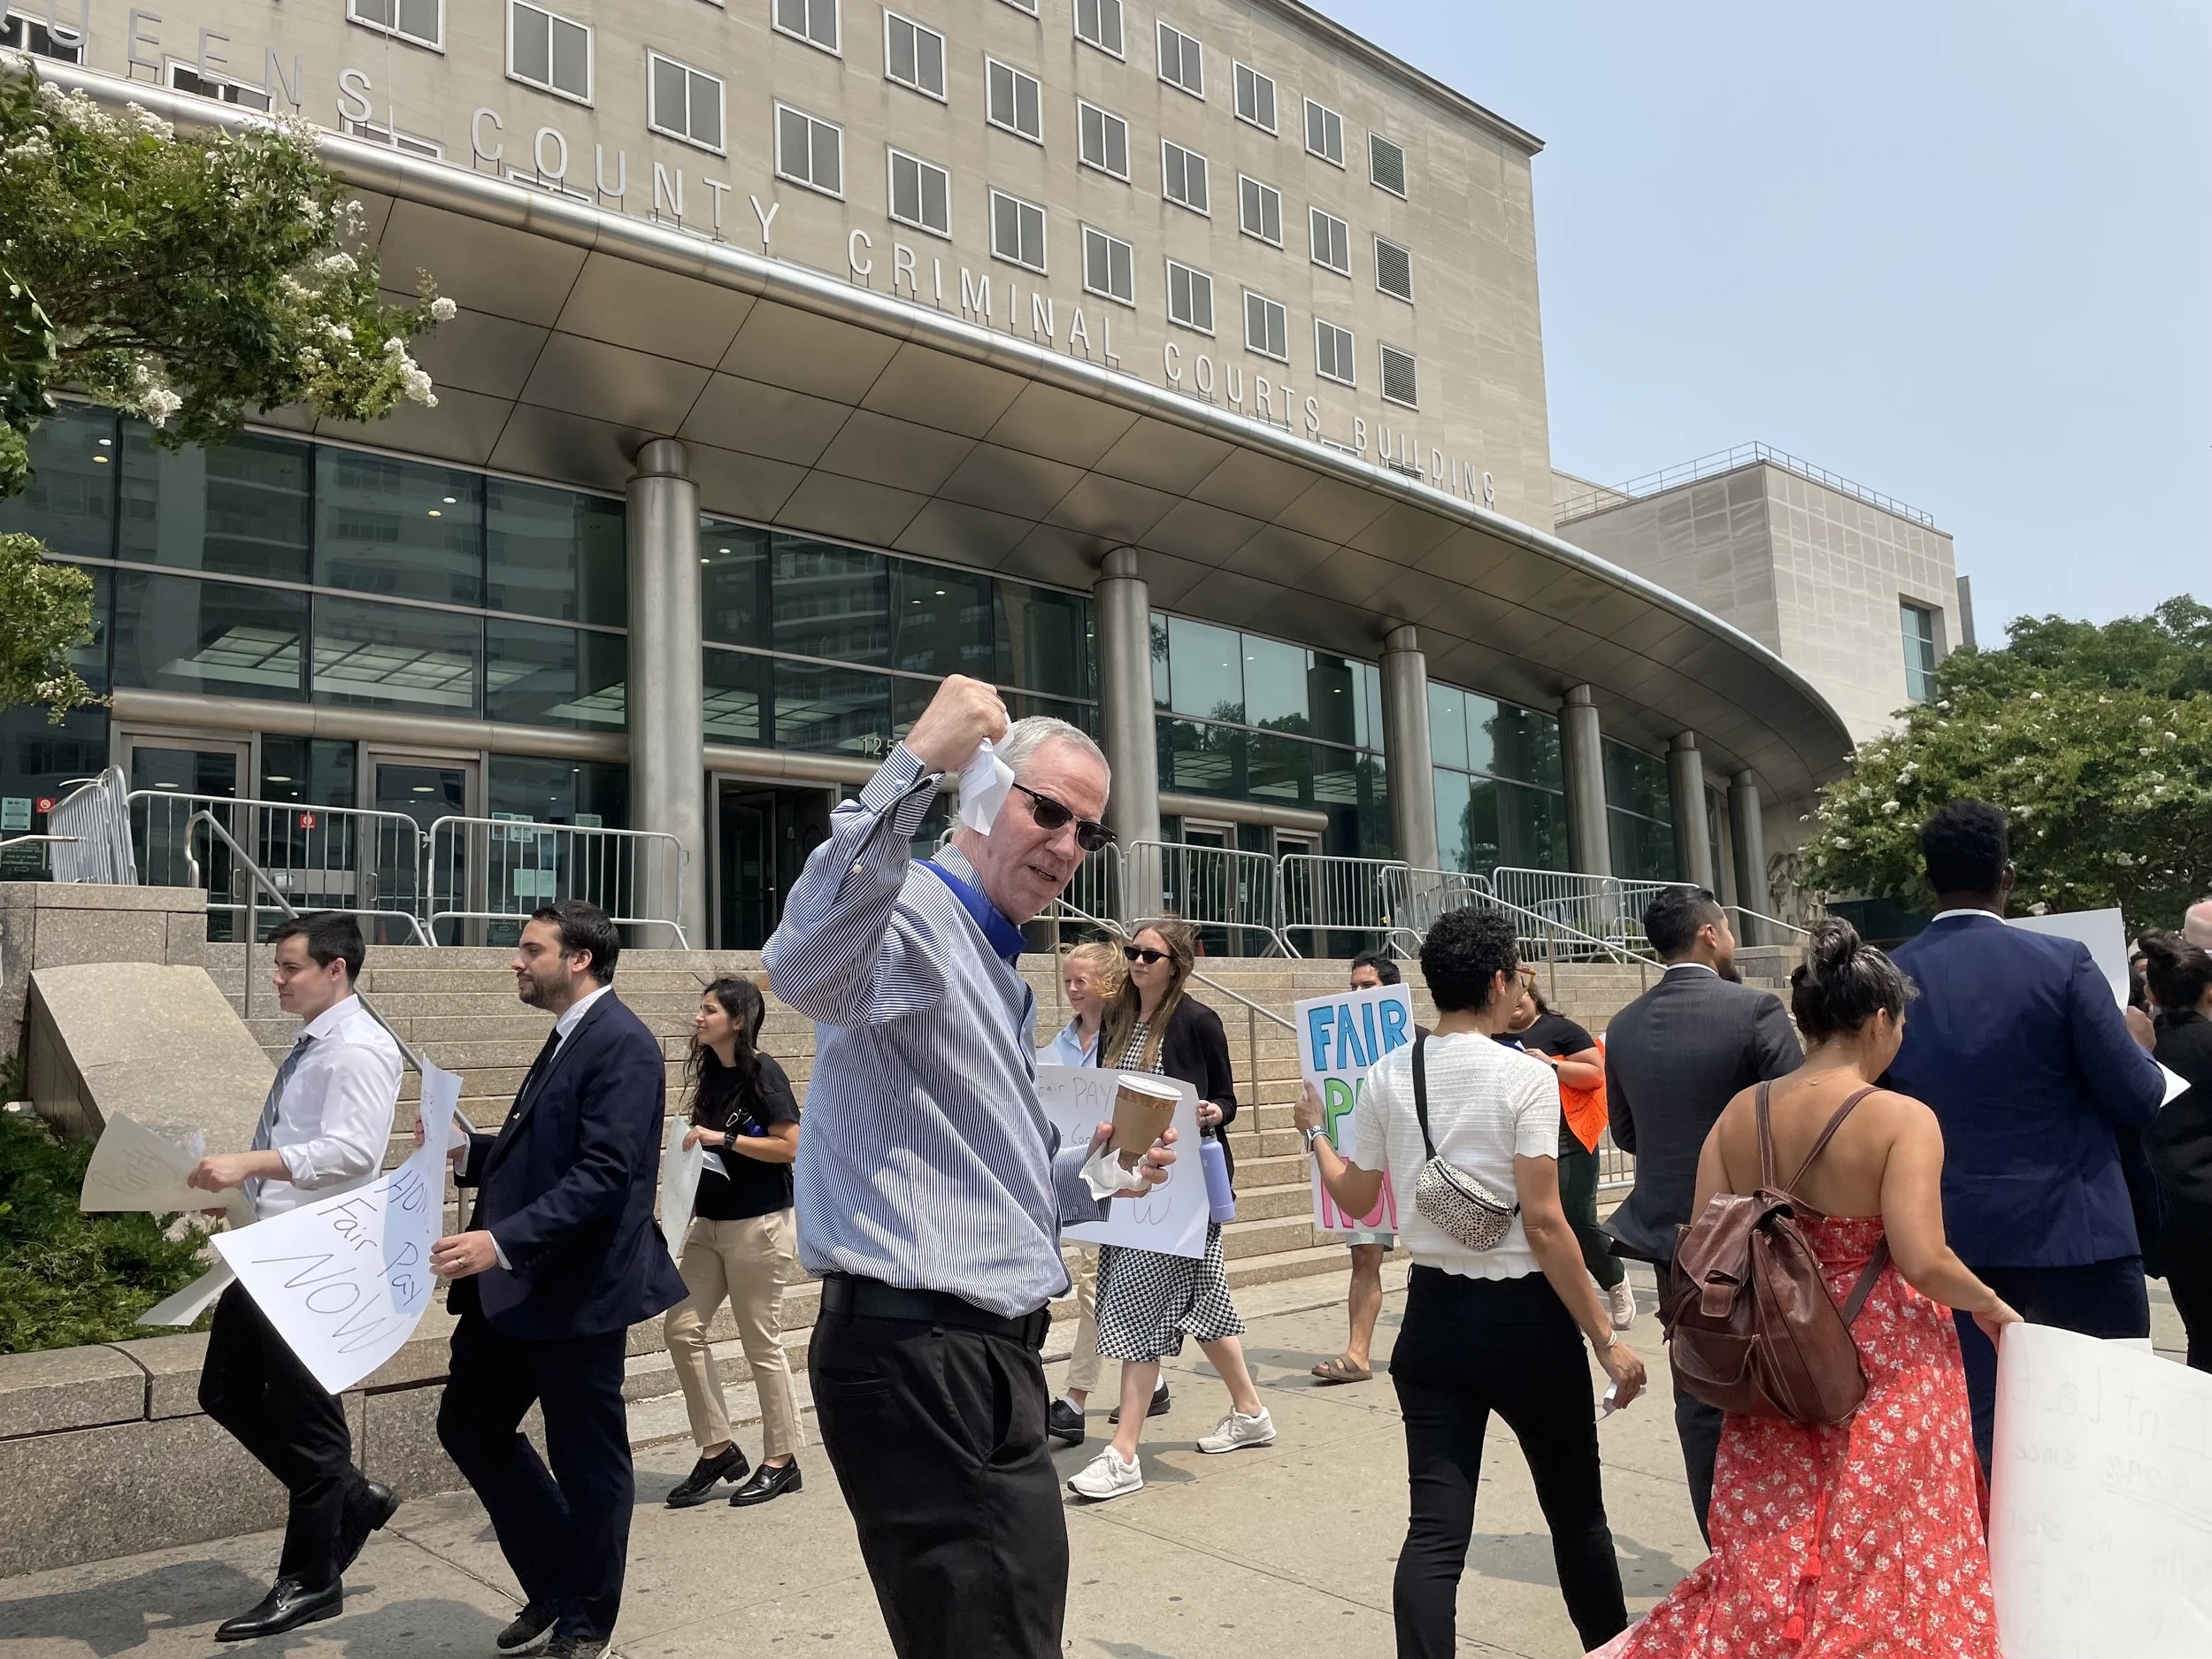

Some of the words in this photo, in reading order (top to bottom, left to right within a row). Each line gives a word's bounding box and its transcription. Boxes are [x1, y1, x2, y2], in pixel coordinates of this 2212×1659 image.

[0, 0, 373, 123] UEENS
[471, 107, 780, 244] COUNTY
[848, 228, 1121, 361] CRIMINAL
[1164, 342, 1320, 432] COURTS
[1353, 416, 1495, 503] BUILDING
[1308, 999, 1408, 1072] FAIR
[1072, 1076, 1112, 1112] PAY
[1324, 1077, 1368, 1150] P
[317, 1197, 379, 1252] Fair
[377, 1241, 424, 1307] Pay
[251, 1253, 405, 1356] NOW
